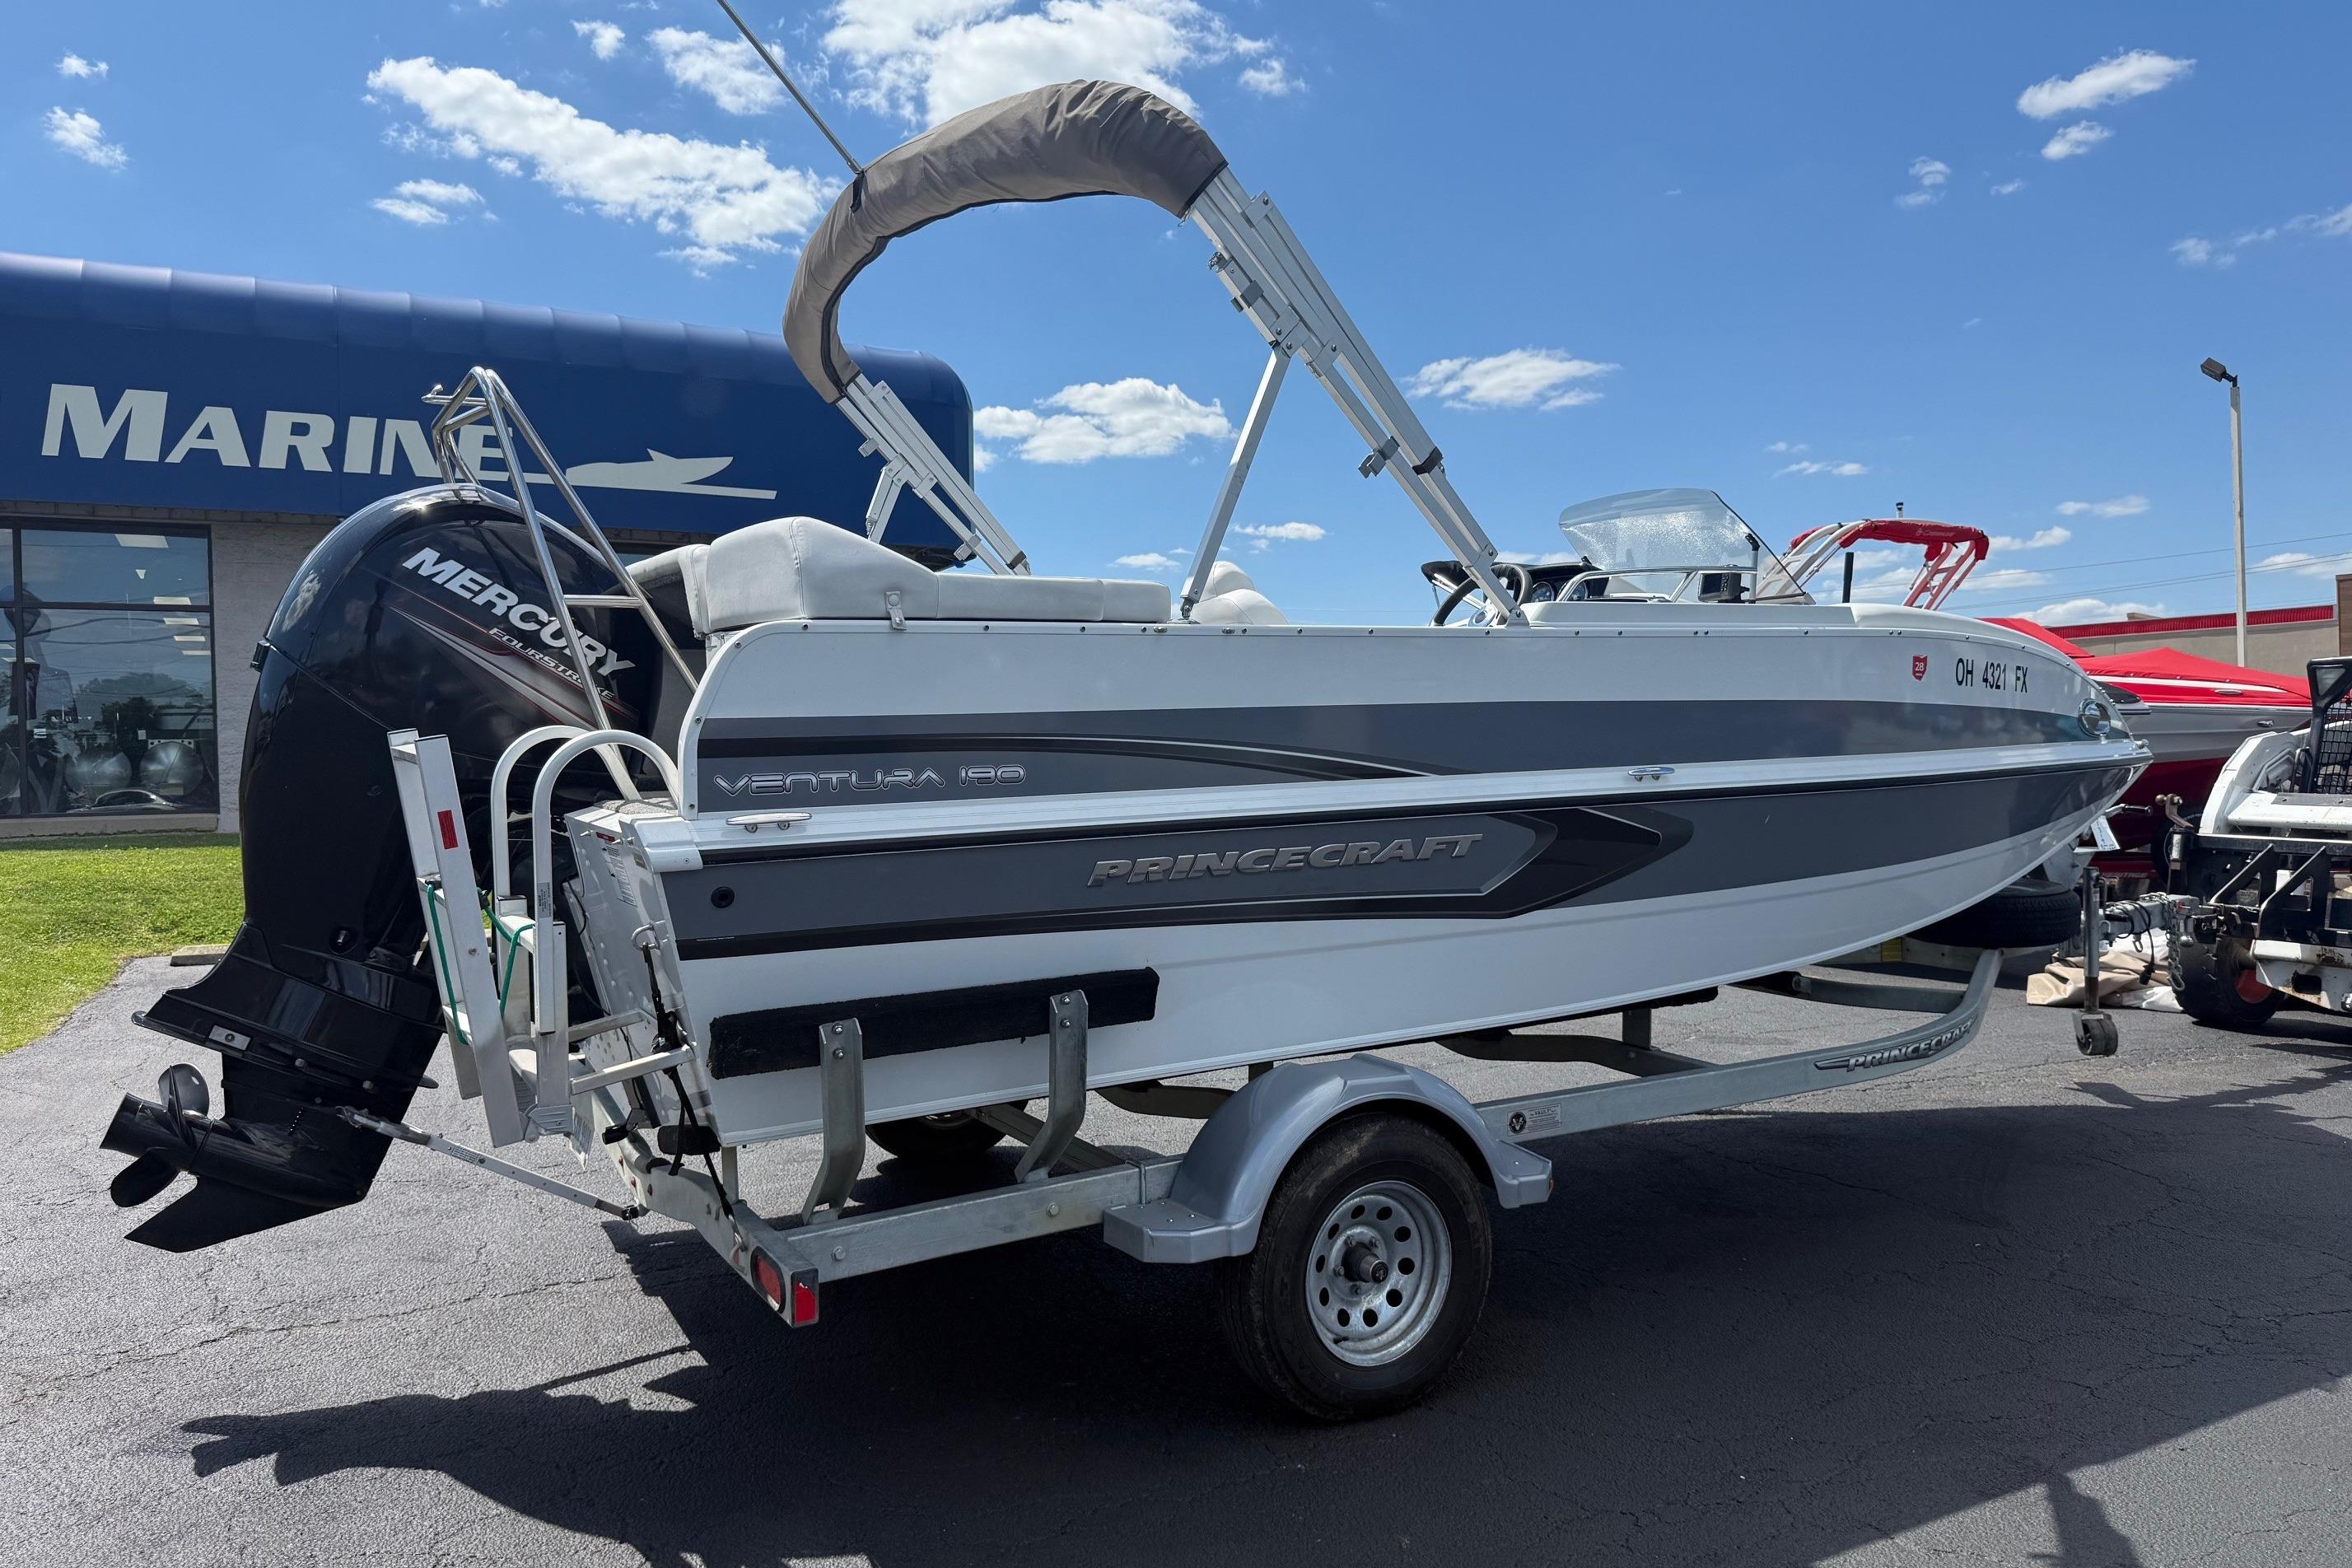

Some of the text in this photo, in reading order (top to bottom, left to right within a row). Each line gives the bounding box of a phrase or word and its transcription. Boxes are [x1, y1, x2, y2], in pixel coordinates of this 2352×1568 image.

[41, 384, 513, 483] MARINE
[402, 547, 636, 676] MERCURY
[1915, 662, 1924, 671] 28
[1955, 657, 2028, 693] OH 4321 FX
[713, 763, 1026, 796] VENTURA 190
[1086, 833, 1483, 887] PRINCECRAFT
